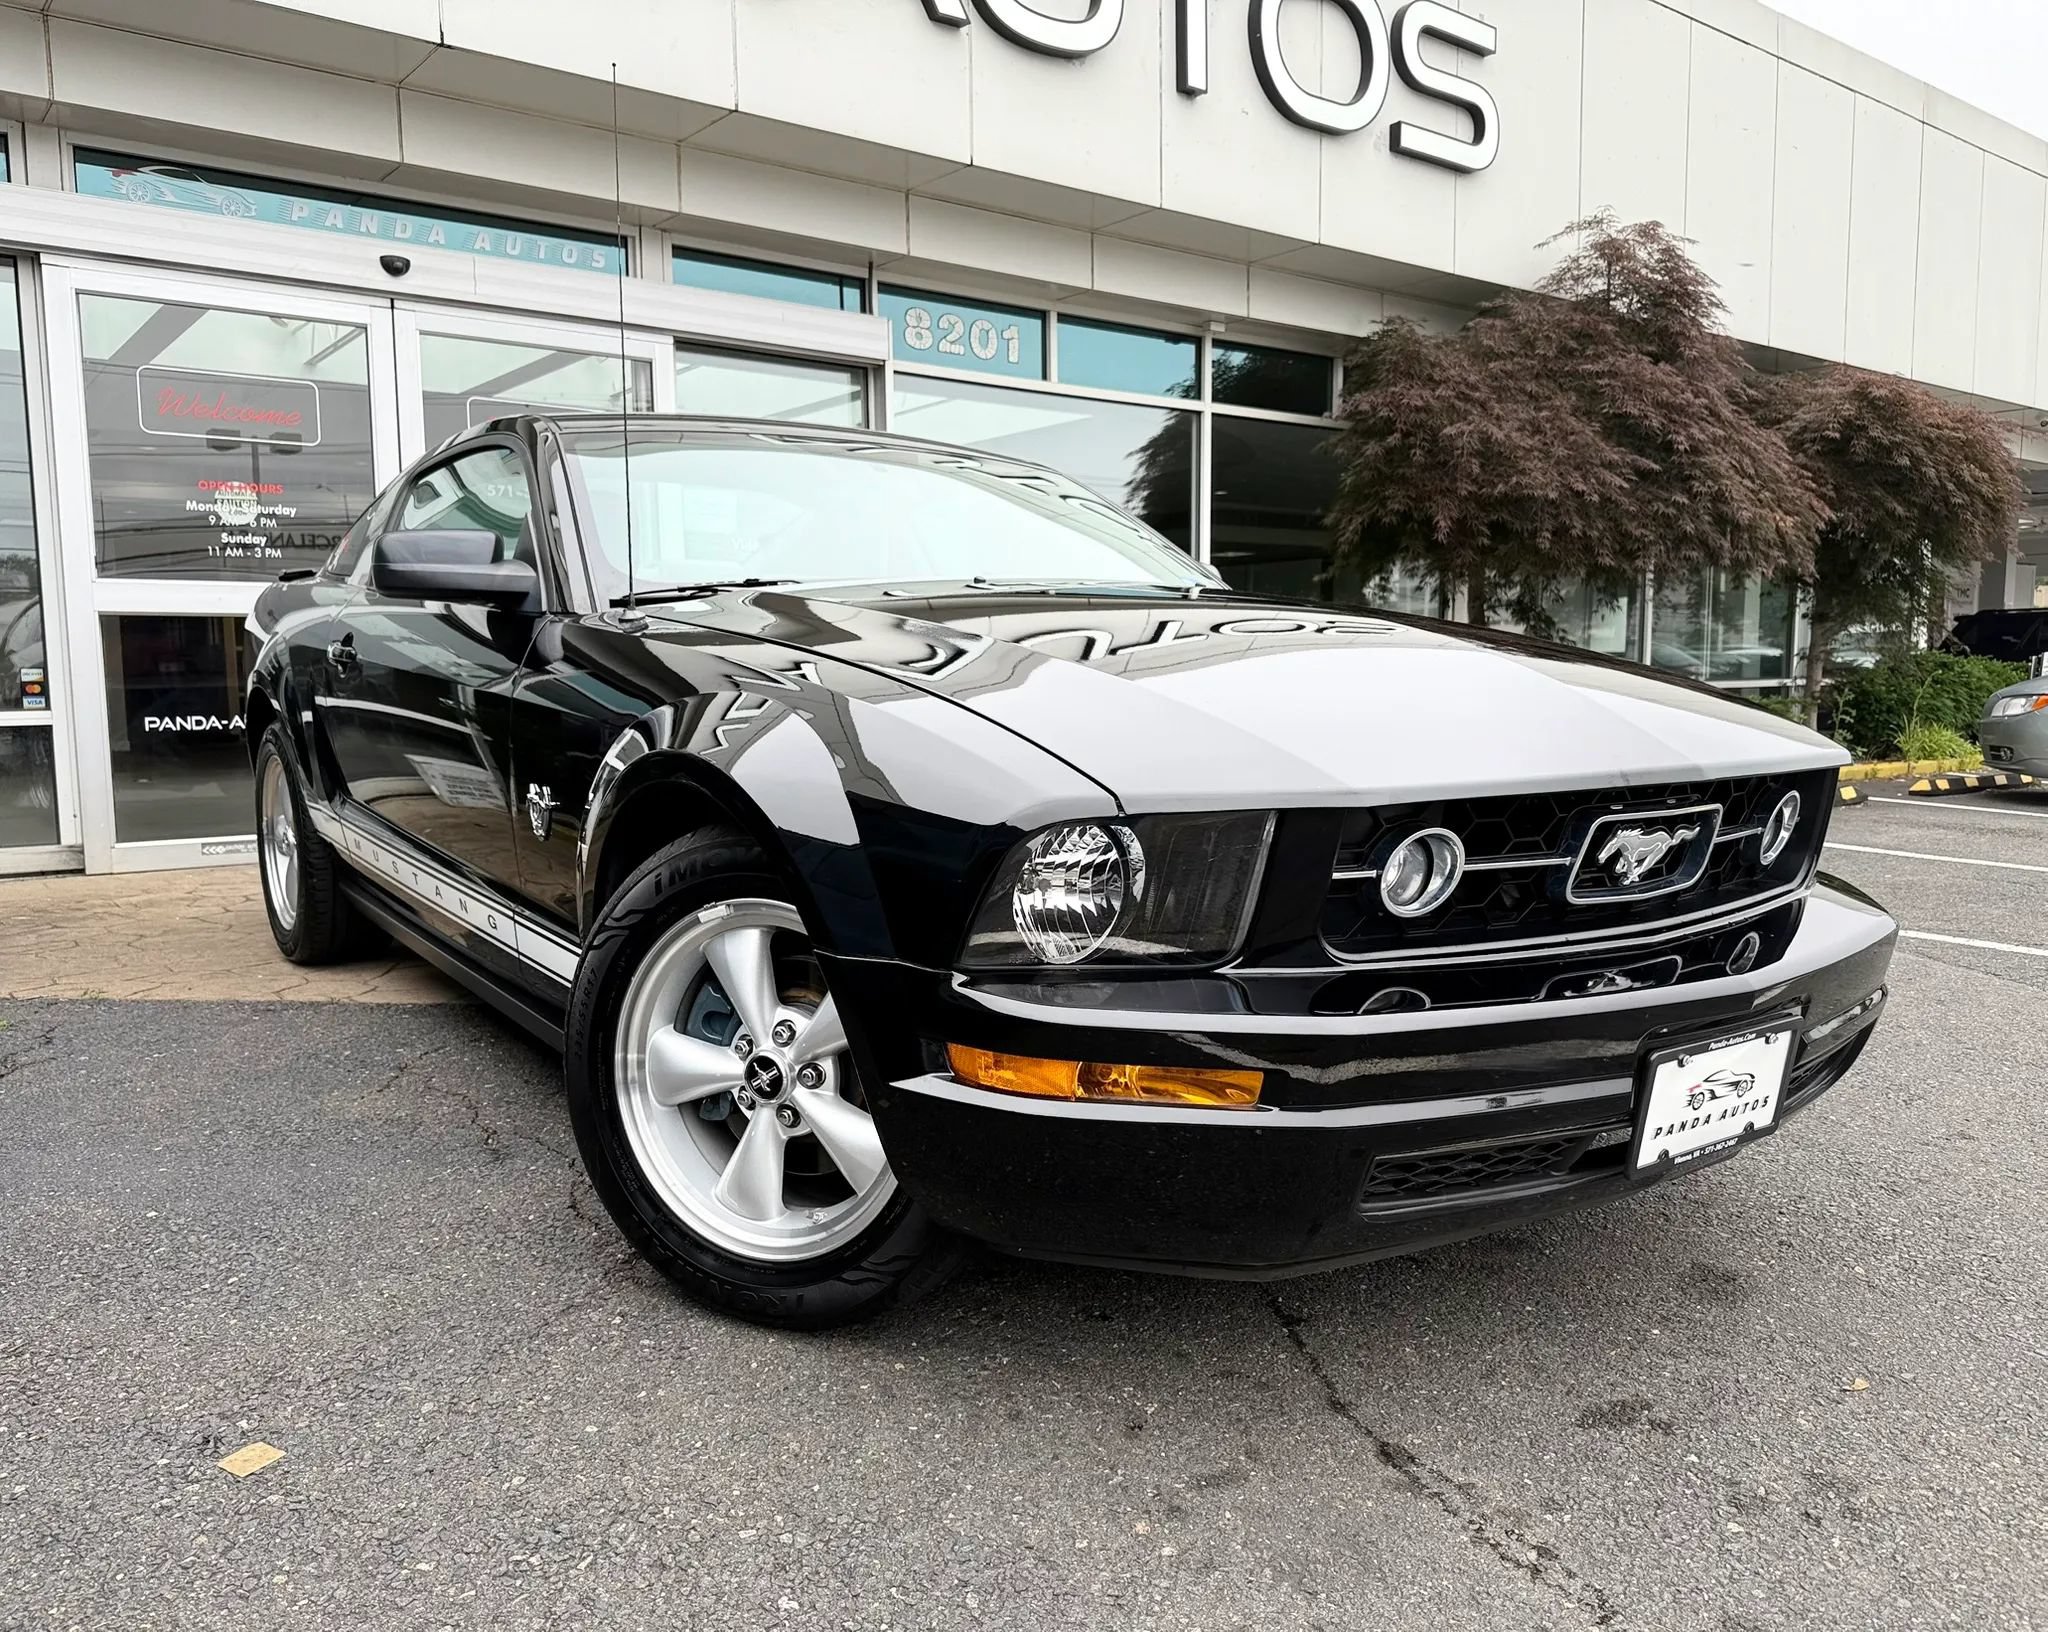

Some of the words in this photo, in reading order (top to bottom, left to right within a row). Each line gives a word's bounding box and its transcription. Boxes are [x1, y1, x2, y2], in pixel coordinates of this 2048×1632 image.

[915, 0, 1500, 173] TOS
[286, 200, 447, 245] PANDA
[472, 230, 608, 269] AUTOS
[904, 307, 1020, 364] 8201
[156, 386, 303, 427] Welcome
[208, 514, 217, 526] 9
[249, 515, 258, 528] 6
[260, 517, 278, 528] PM
[221, 532, 268, 547] Sunday
[207, 546, 220, 557] 11
[224, 547, 244, 557] AM
[254, 548, 262, 558] 3
[265, 549, 282, 558] PM
[144, 715, 247, 732] PANDA-A
[354, 838, 498, 931] MUSTANG
[1653, 1113, 1712, 1140] PANDA
[1719, 1096, 1770, 1121] AUTOS
